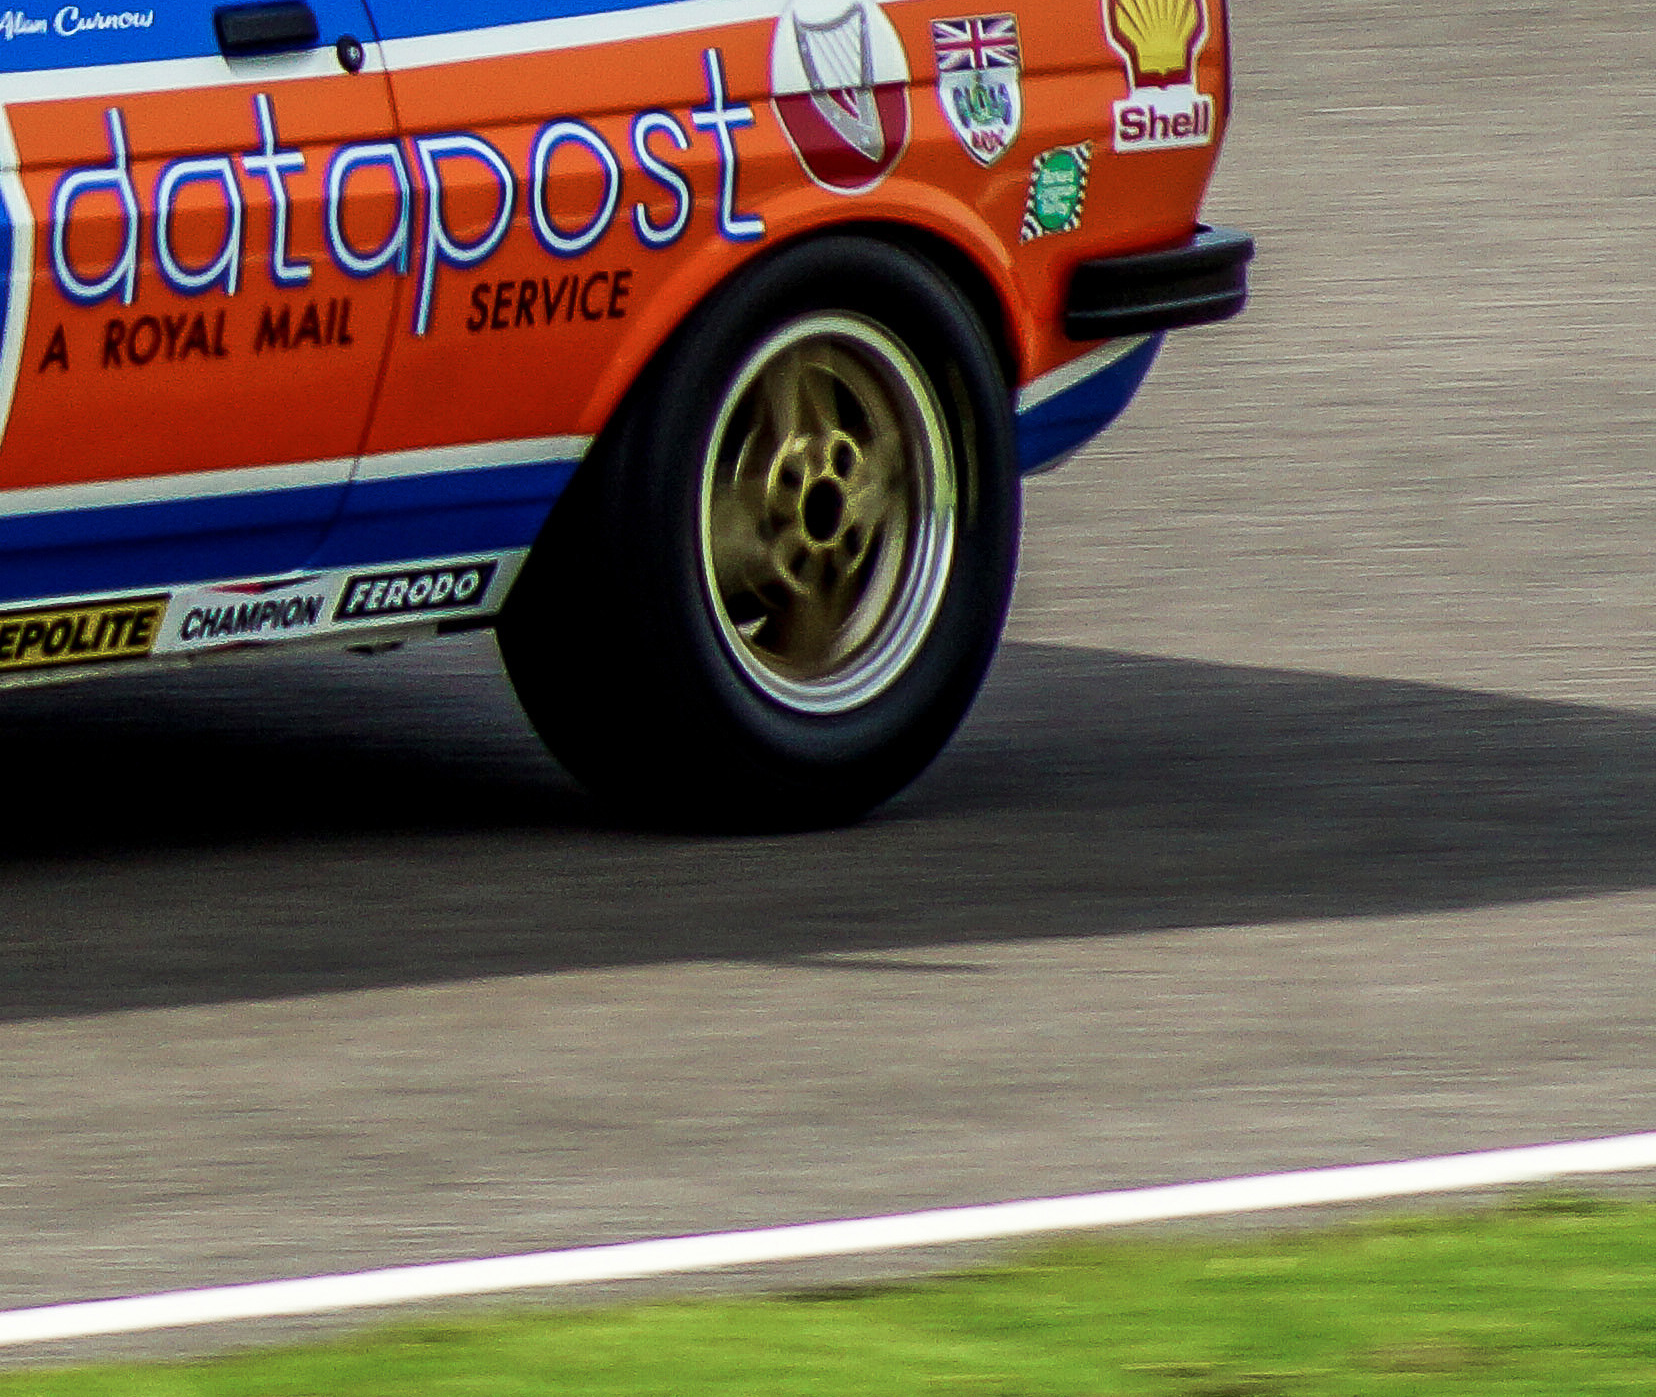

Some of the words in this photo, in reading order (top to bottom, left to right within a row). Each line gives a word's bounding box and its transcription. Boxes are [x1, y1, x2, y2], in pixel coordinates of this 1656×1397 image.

[53, 5, 154, 37] Curnow
[1118, 101, 1210, 142] Shell
[49, 48, 767, 337] datapost
[38, 321, 70, 374] A
[101, 311, 229, 370] ROYAL
[254, 299, 354, 354] MAIL
[465, 270, 633, 333] SERVICE
[343, 567, 483, 615] FERODO
[178, 593, 326, 643] CHAMPION
